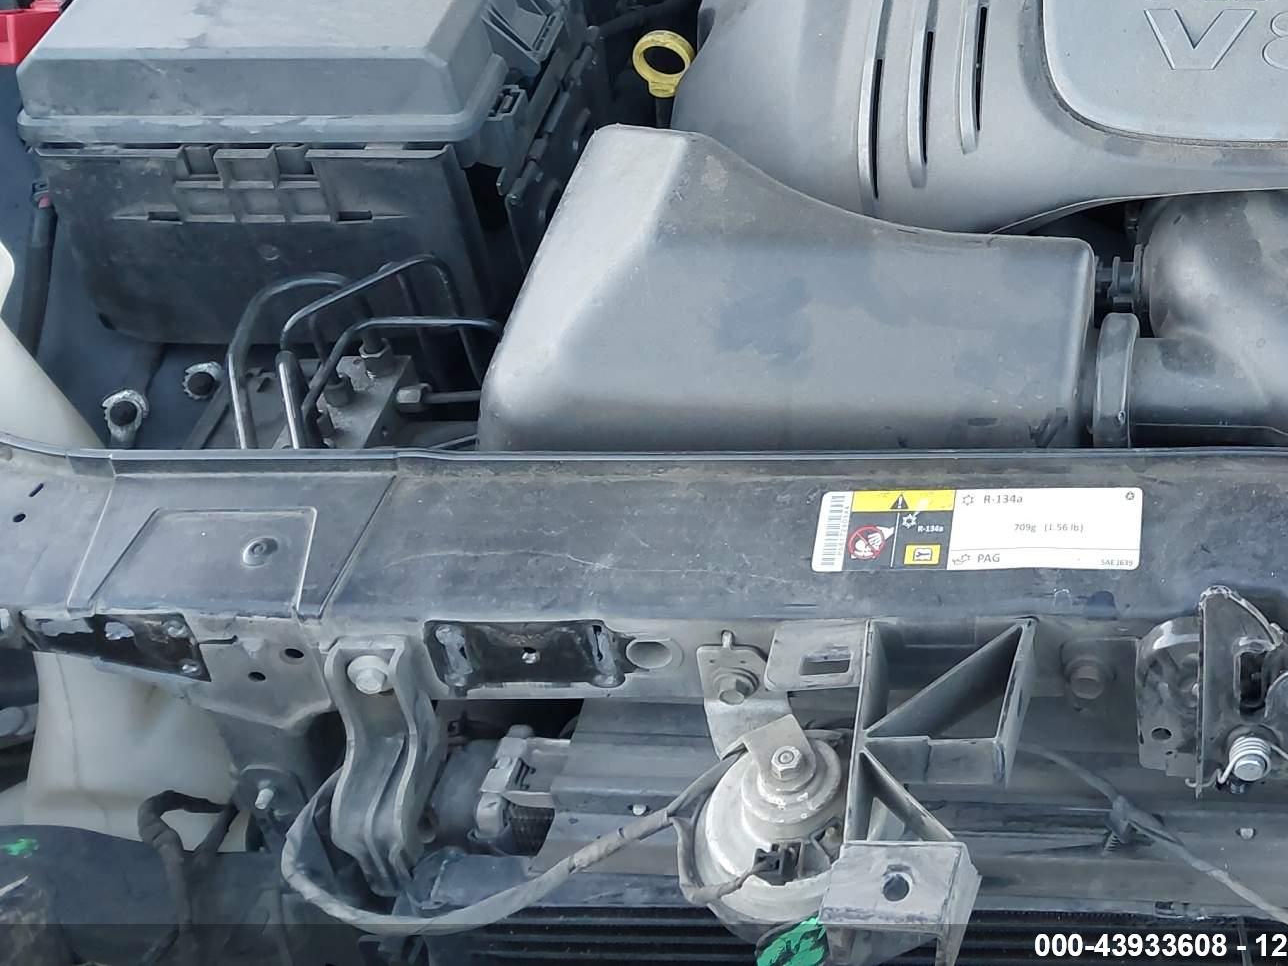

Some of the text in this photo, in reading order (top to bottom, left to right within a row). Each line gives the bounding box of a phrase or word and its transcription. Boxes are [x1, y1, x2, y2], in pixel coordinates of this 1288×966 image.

[984, 495, 1023, 504] R-134a
[917, 524, 944, 534] R-134a
[1014, 522, 1037, 534] 709g
[977, 553, 1000, 563] PAG
